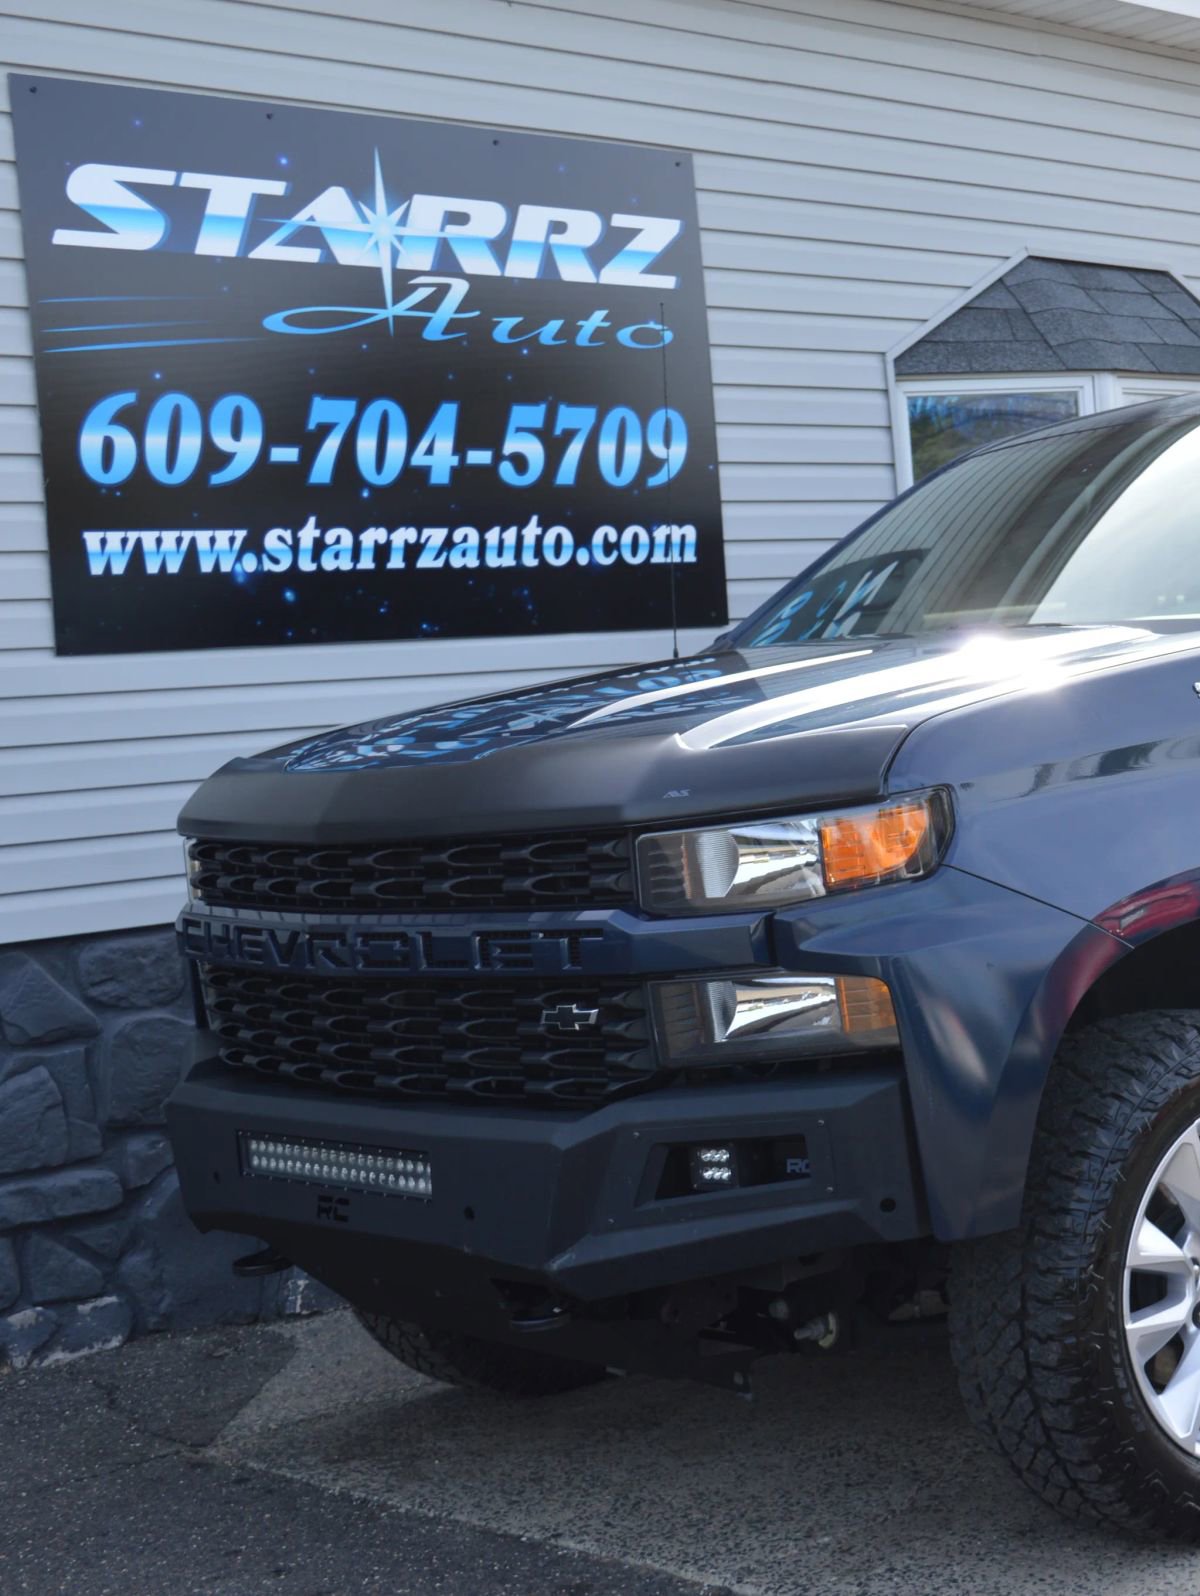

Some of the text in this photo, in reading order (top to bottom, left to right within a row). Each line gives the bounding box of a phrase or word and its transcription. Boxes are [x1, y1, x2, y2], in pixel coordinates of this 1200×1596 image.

[52, 162, 683, 289] STARRZ
[262, 276, 675, 349] Auto
[79, 391, 689, 488] 609-704-5709
[83, 515, 697, 576] www.starrzauto.com
[181, 915, 604, 971] CHEVROLET
